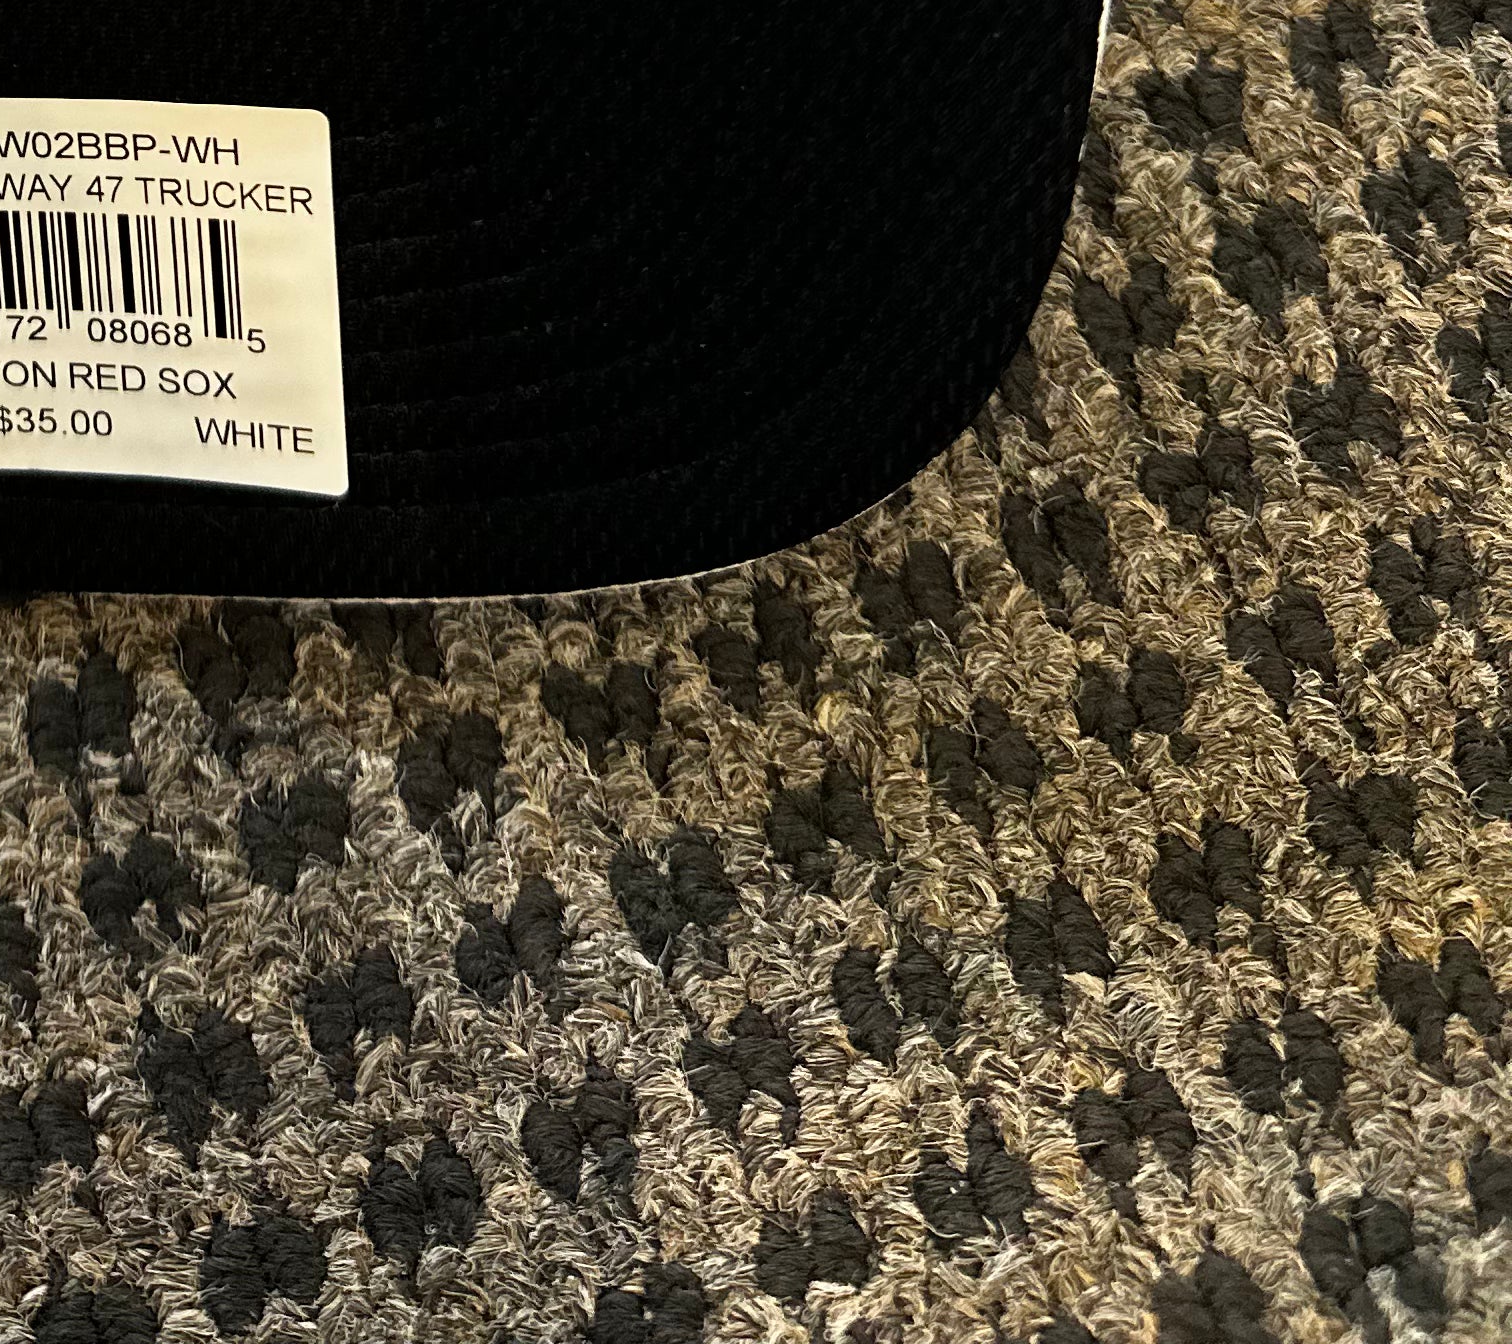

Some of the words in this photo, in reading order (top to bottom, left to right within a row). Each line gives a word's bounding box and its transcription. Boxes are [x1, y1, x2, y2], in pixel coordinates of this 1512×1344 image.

[85, 175, 124, 204] 47
[134, 177, 313, 216] TRUCKER
[87, 317, 193, 348] 08068
[247, 327, 266, 354] 5
[68, 362, 146, 392] RED
[158, 367, 237, 400] SOX
[194, 416, 315, 455] WHITE
